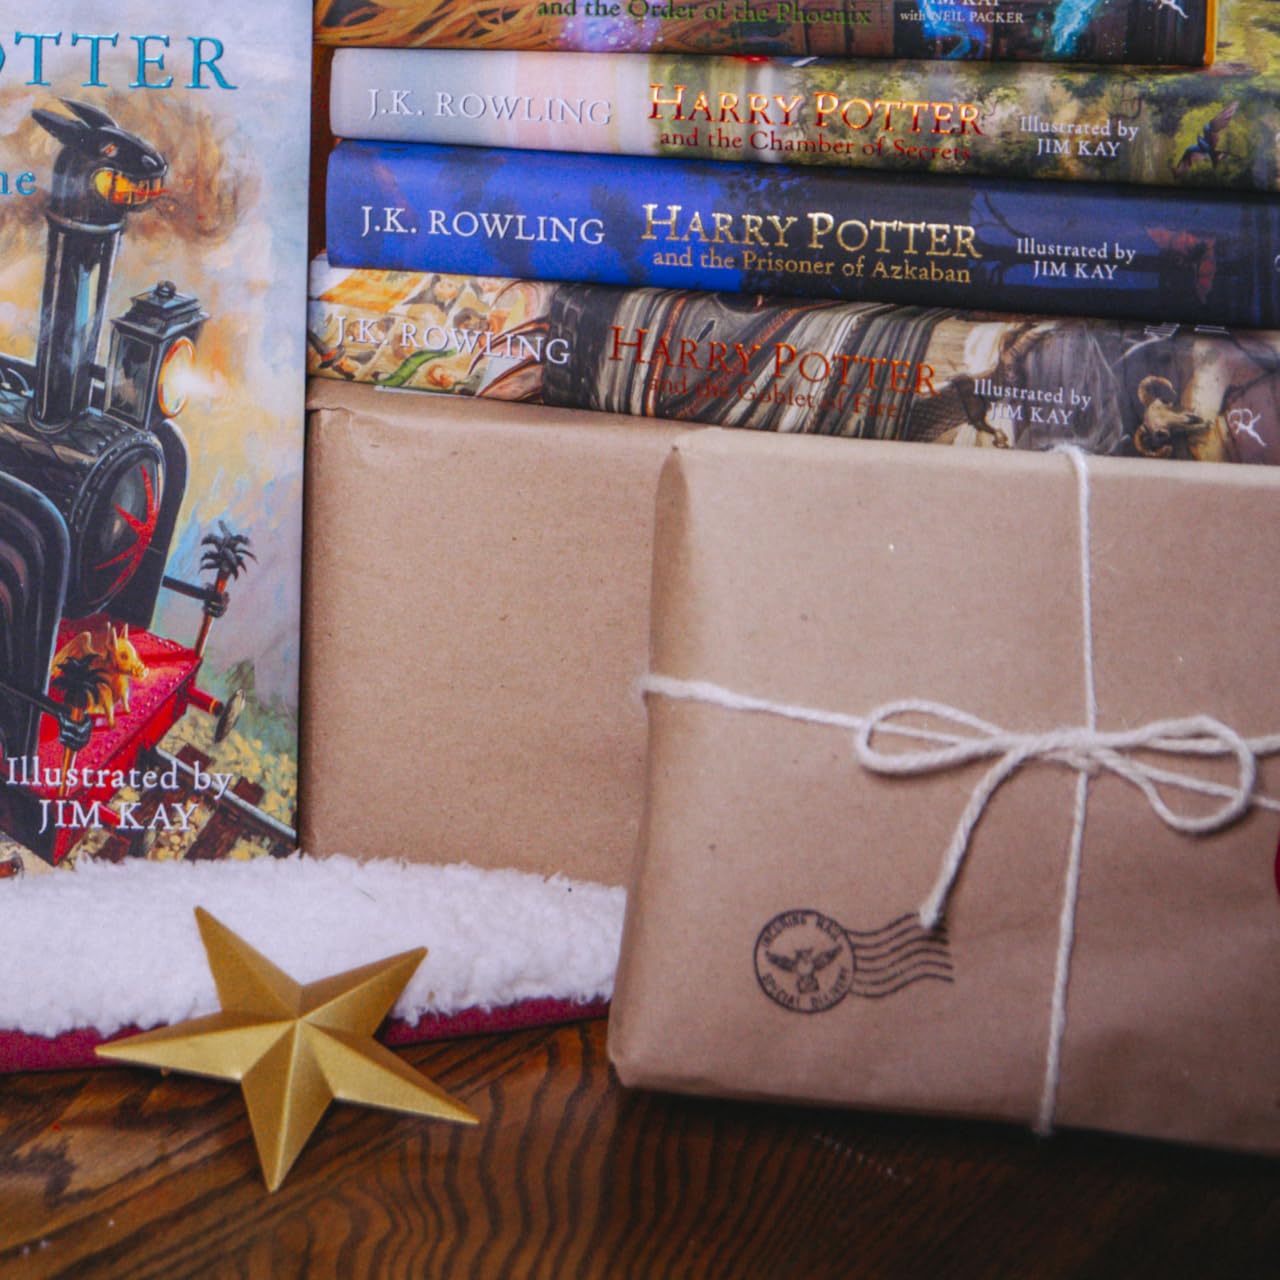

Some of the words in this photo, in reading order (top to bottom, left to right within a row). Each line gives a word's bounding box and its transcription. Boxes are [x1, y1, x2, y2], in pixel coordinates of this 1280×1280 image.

[703, 0, 728, 20] of
[732, 0, 770, 22] the
[777, 1, 872, 26] Phoenix
[900, 9, 926, 22] with
[931, 10, 965, 23] NEIL
[969, 11, 1025, 24] PACKER
[368, 89, 425, 118] J.K.
[435, 92, 612, 126] ROWLING
[648, 83, 805, 127] HARRY
[813, 92, 985, 136] POTTER
[1020, 116, 1113, 137] Illustrated
[1117, 119, 1139, 141] by
[660, 131, 700, 148] and
[708, 131, 742, 150] the
[749, 131, 855, 156] Chamber
[862, 137, 886, 157] of
[893, 139, 971, 162] Secrets
[1037, 138, 1073, 156] JIM
[1077, 140, 1121, 158] KAY
[361, 206, 417, 236] J.K.
[428, 210, 606, 245] ROWLING
[641, 204, 798, 248] HARRY
[807, 212, 983, 259] POTTER
[653, 249, 693, 268] and
[701, 250, 735, 269] the
[742, 250, 834, 276] Prisoner
[842, 257, 865, 277] of
[871, 258, 971, 285] Azkaban
[1017, 238, 1108, 259] Illustrated
[1114, 241, 1137, 264] by
[1033, 260, 1068, 280] JIM
[1074, 262, 1118, 280] KAY
[334, 317, 389, 348] J.K.
[400, 322, 571, 365] ROWLING
[609, 325, 761, 376] HARRY
[774, 342, 941, 398] POTTER
[650, 375, 687, 395] and
[695, 380, 730, 399] the
[737, 381, 816, 409] Goblet
[822, 392, 845, 413] of
[848, 394, 899, 418] Fire
[974, 378, 1065, 405] Illustrated
[1071, 388, 1093, 411] by
[988, 402, 1024, 424] JIM
[1030, 407, 1074, 426] KAY
[6, 756, 179, 790] Illustrated
[192, 762, 233, 800] by
[39, 800, 104, 835] JIM
[118, 803, 198, 833] KAY
